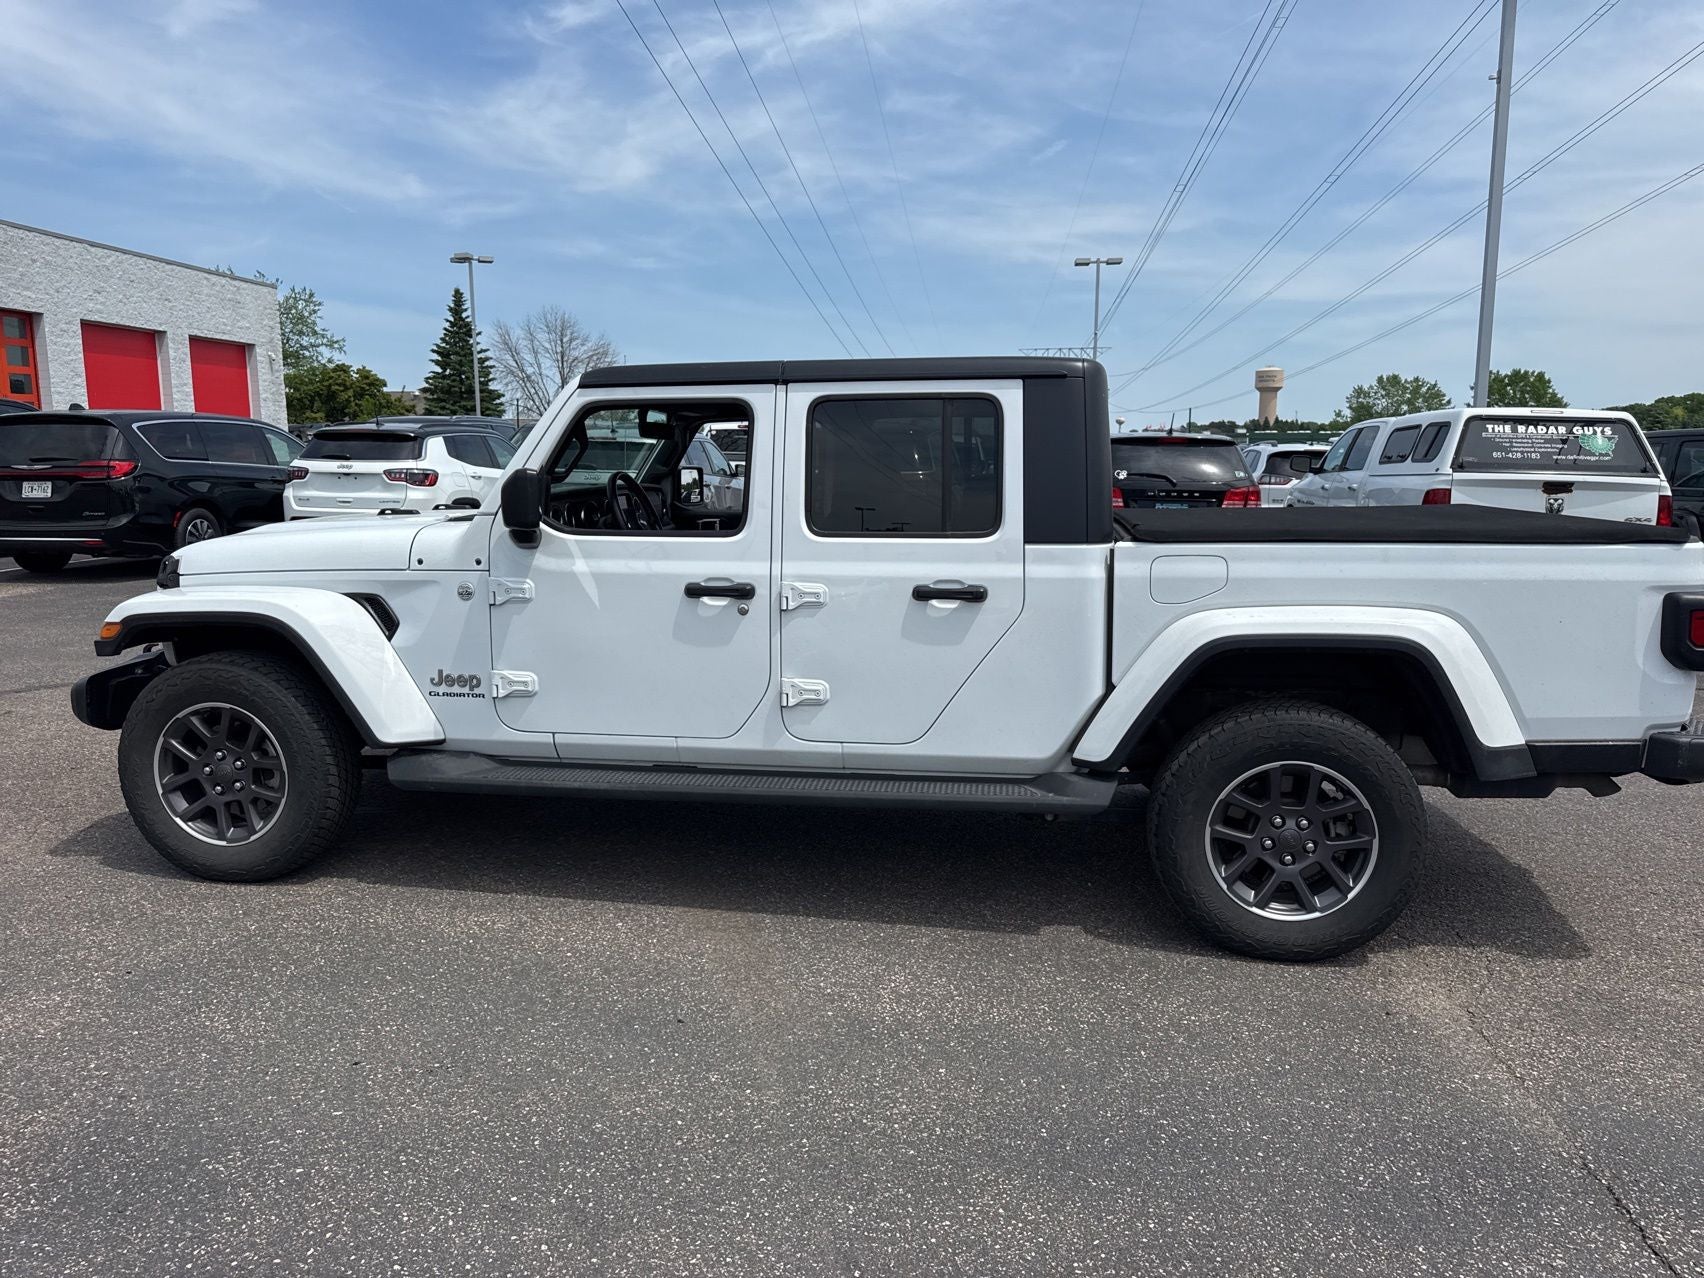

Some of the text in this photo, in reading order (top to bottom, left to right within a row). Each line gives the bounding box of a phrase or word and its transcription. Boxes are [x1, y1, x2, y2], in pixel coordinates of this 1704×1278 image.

[1486, 424, 1512, 433] THE
[1517, 425, 1567, 435] RADAR
[1572, 426, 1613, 437] GUYS
[1492, 452, 1541, 460] 651-428-1183
[430, 669, 481, 691] Jeep
[428, 691, 486, 699] GLADIATOR
